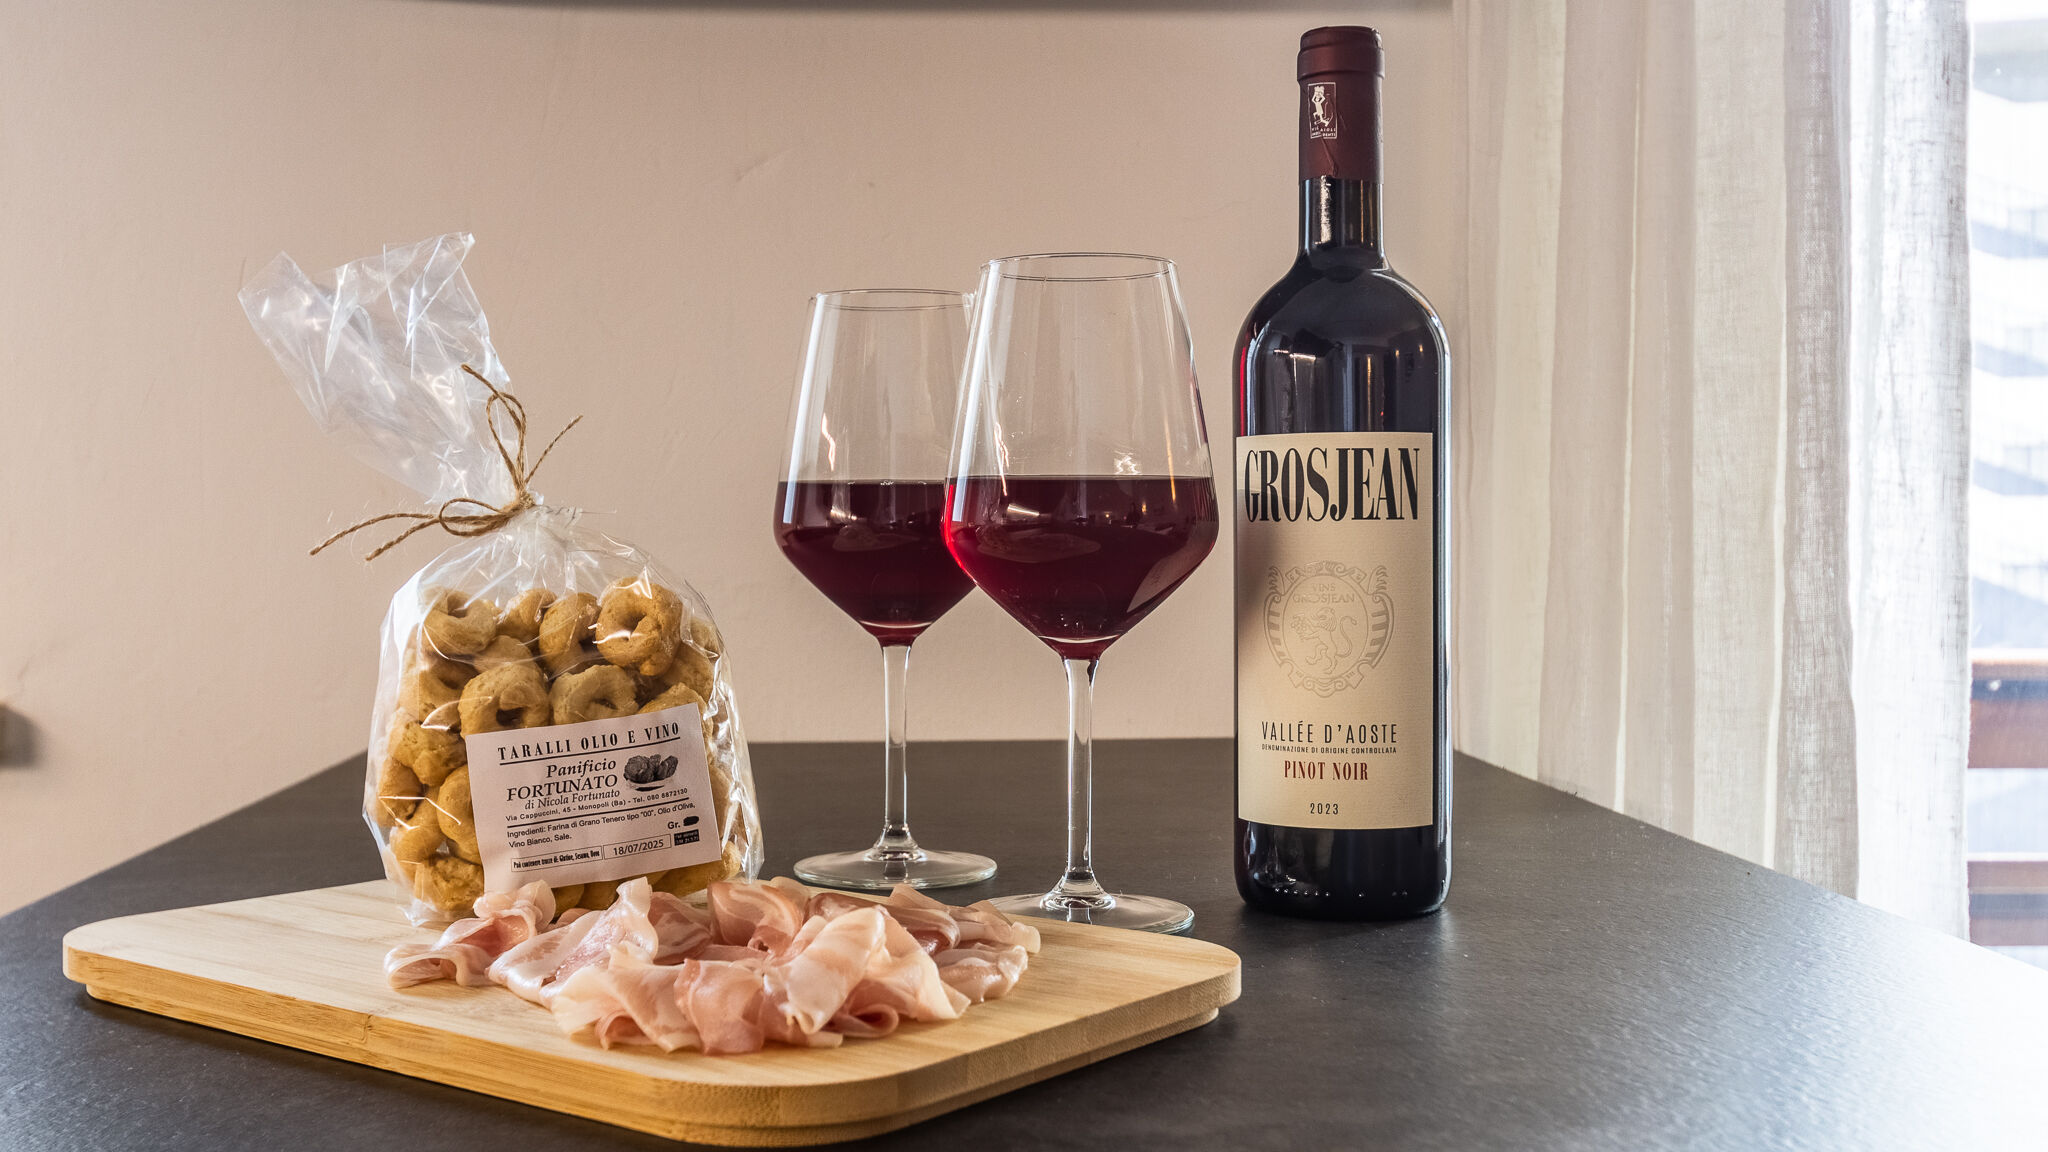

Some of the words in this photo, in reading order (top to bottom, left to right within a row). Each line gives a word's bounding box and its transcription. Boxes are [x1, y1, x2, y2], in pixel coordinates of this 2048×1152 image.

[1245, 447, 1420, 522] GROSJEAN
[1311, 583, 1336, 592] VINS
[498, 739, 571, 760] TARALLI
[581, 733, 618, 750] OLIO
[628, 730, 636, 744] E
[644, 722, 679, 740] VINO
[1261, 720, 1313, 743] VALLÉE
[1324, 724, 1397, 744] D'AOSTE
[1261, 743, 1309, 753] DENOMINAZIONE
[546, 758, 617, 778] Panificio
[1284, 760, 1325, 779] PINOT
[1333, 762, 1368, 780] NOIR
[507, 774, 618, 801] FORTUNATO
[525, 799, 534, 810] di
[537, 795, 569, 809] Nicola
[572, 788, 620, 803] Fortunato
[1310, 803, 1339, 815] 2023
[520, 808, 561, 819] Cappuccini,
[578, 801, 609, 811] Monopoli
[612, 800, 626, 808] (Ba)
[507, 826, 546, 839] Ingredienti:
[548, 823, 570, 832] Farina
[579, 818, 601, 827] Grano
[602, 815, 626, 824] Tenero
[627, 813, 640, 822] tipo
[658, 807, 671, 815] Olio
[667, 821, 681, 830] Gr.
[509, 840, 525, 848] Vino
[527, 837, 552, 847] Bianco,
[554, 833, 572, 841] Sale.
[613, 839, 664, 856] 18/07/2025
